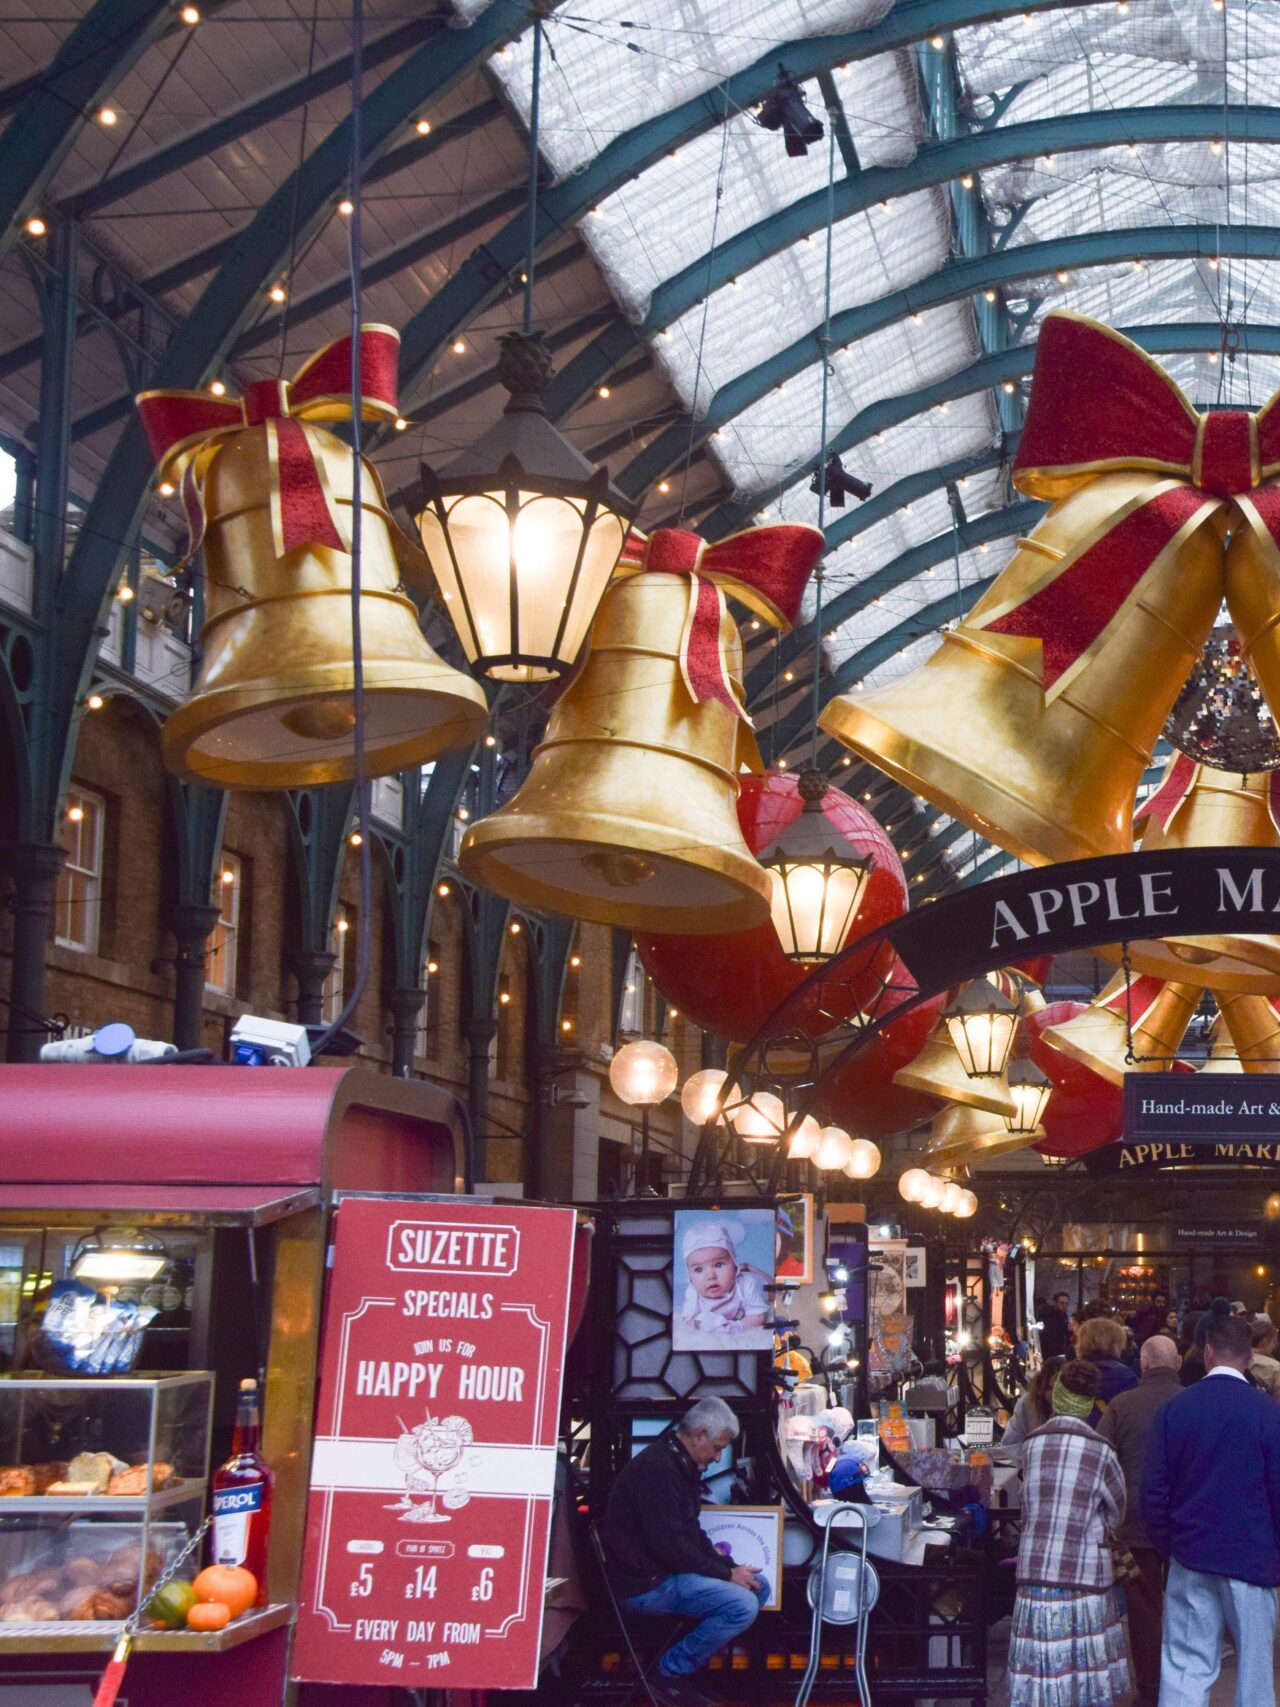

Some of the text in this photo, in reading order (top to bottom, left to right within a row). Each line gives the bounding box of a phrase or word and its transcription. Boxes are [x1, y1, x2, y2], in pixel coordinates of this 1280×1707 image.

[989, 871, 1179, 949] APPLE
[1141, 1099, 1234, 1115] Hand-made
[1238, 1101, 1264, 1115] Art
[1119, 1143, 1195, 1168] APPLE
[1178, 1228, 1215, 1237] Hand-made
[1216, 1229, 1226, 1237] Art
[1235, 1229, 1257, 1238] Design
[398, 1229, 510, 1267] SUZETTE
[402, 1290, 494, 1319] SPECIALS
[413, 1338, 477, 1358] JOIN US FOR
[356, 1360, 525, 1402] HAPPY HOUR
[350, 1562, 374, 1597] £5
[405, 1564, 438, 1599] £14
[471, 1567, 494, 1601] £6
[355, 1619, 481, 1644] EVERY DAY FROM
[379, 1648, 405, 1668] 5PM
[426, 1650, 451, 1669] 7PM
